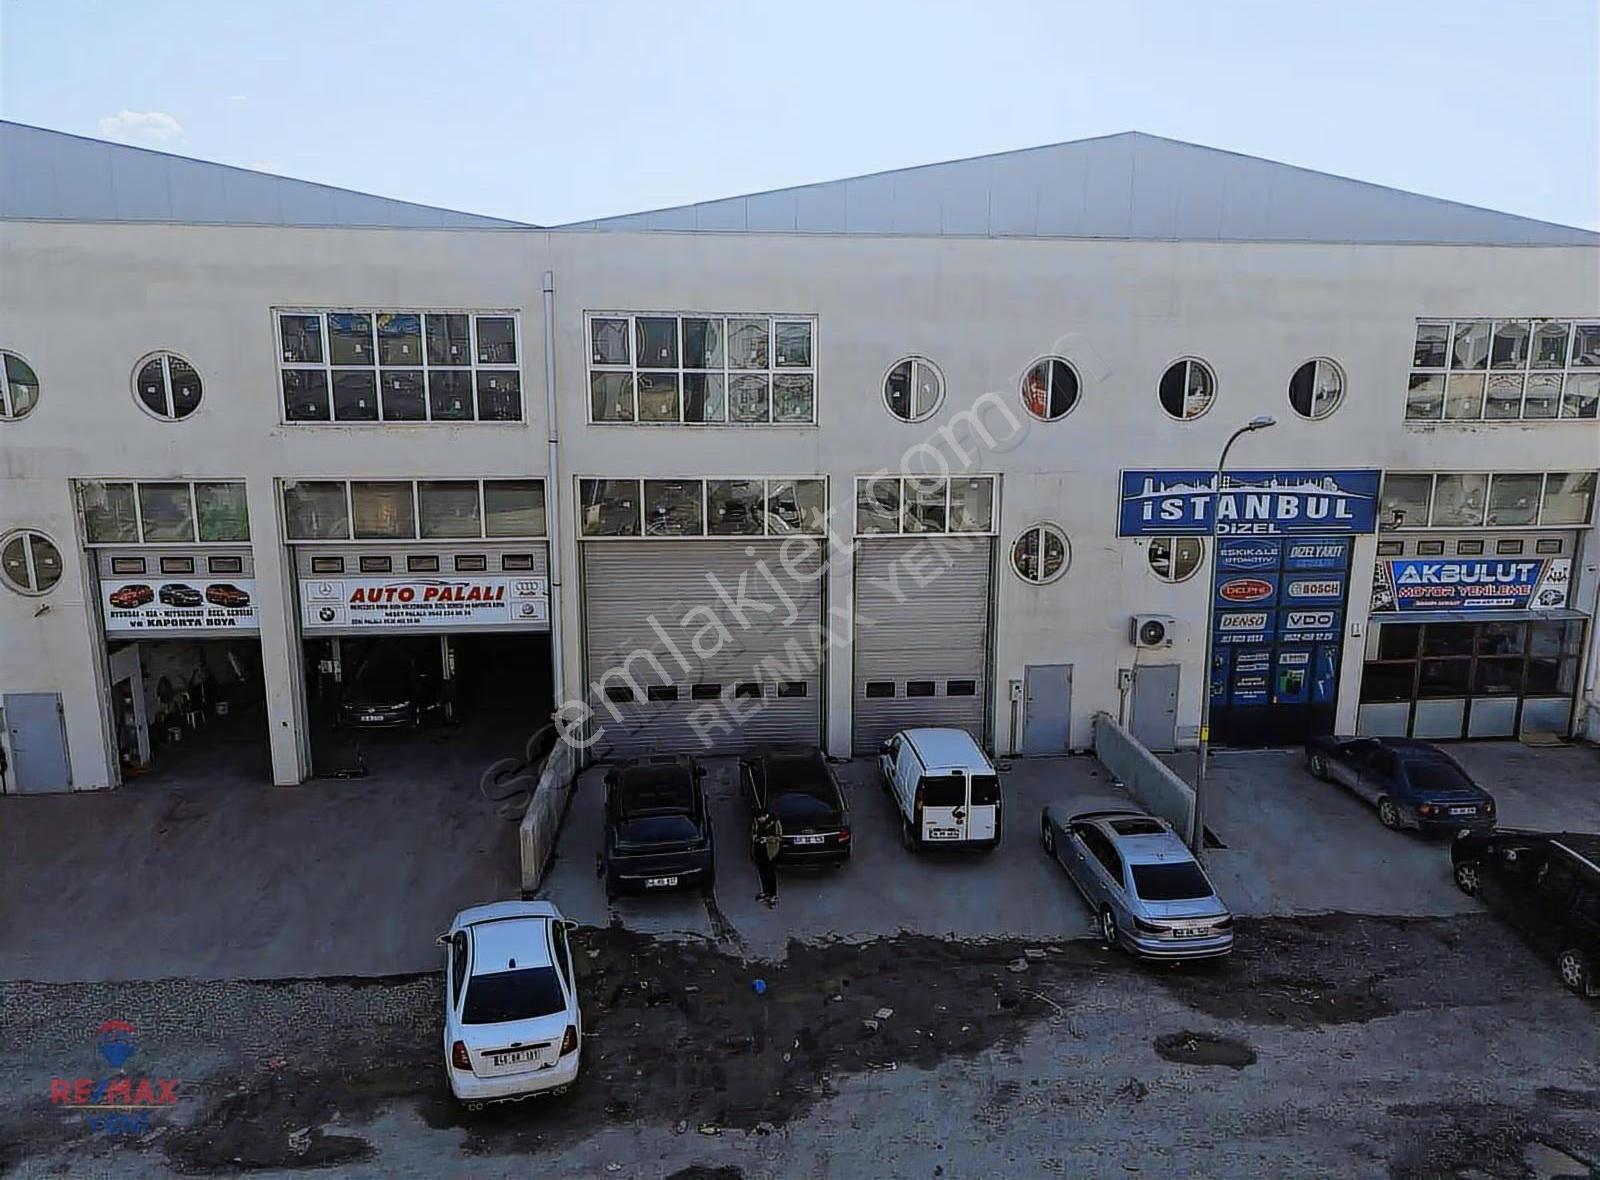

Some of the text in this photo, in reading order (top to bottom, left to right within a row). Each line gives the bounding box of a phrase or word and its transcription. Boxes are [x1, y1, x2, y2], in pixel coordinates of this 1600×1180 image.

[1397, 563, 1535, 584] AKBULUT
[1303, 583, 1338, 594] BOSCH
[349, 586, 505, 603] AUTO PALALI
[1223, 616, 1264, 626] DENSO
[1290, 615, 1331, 625] VDO
